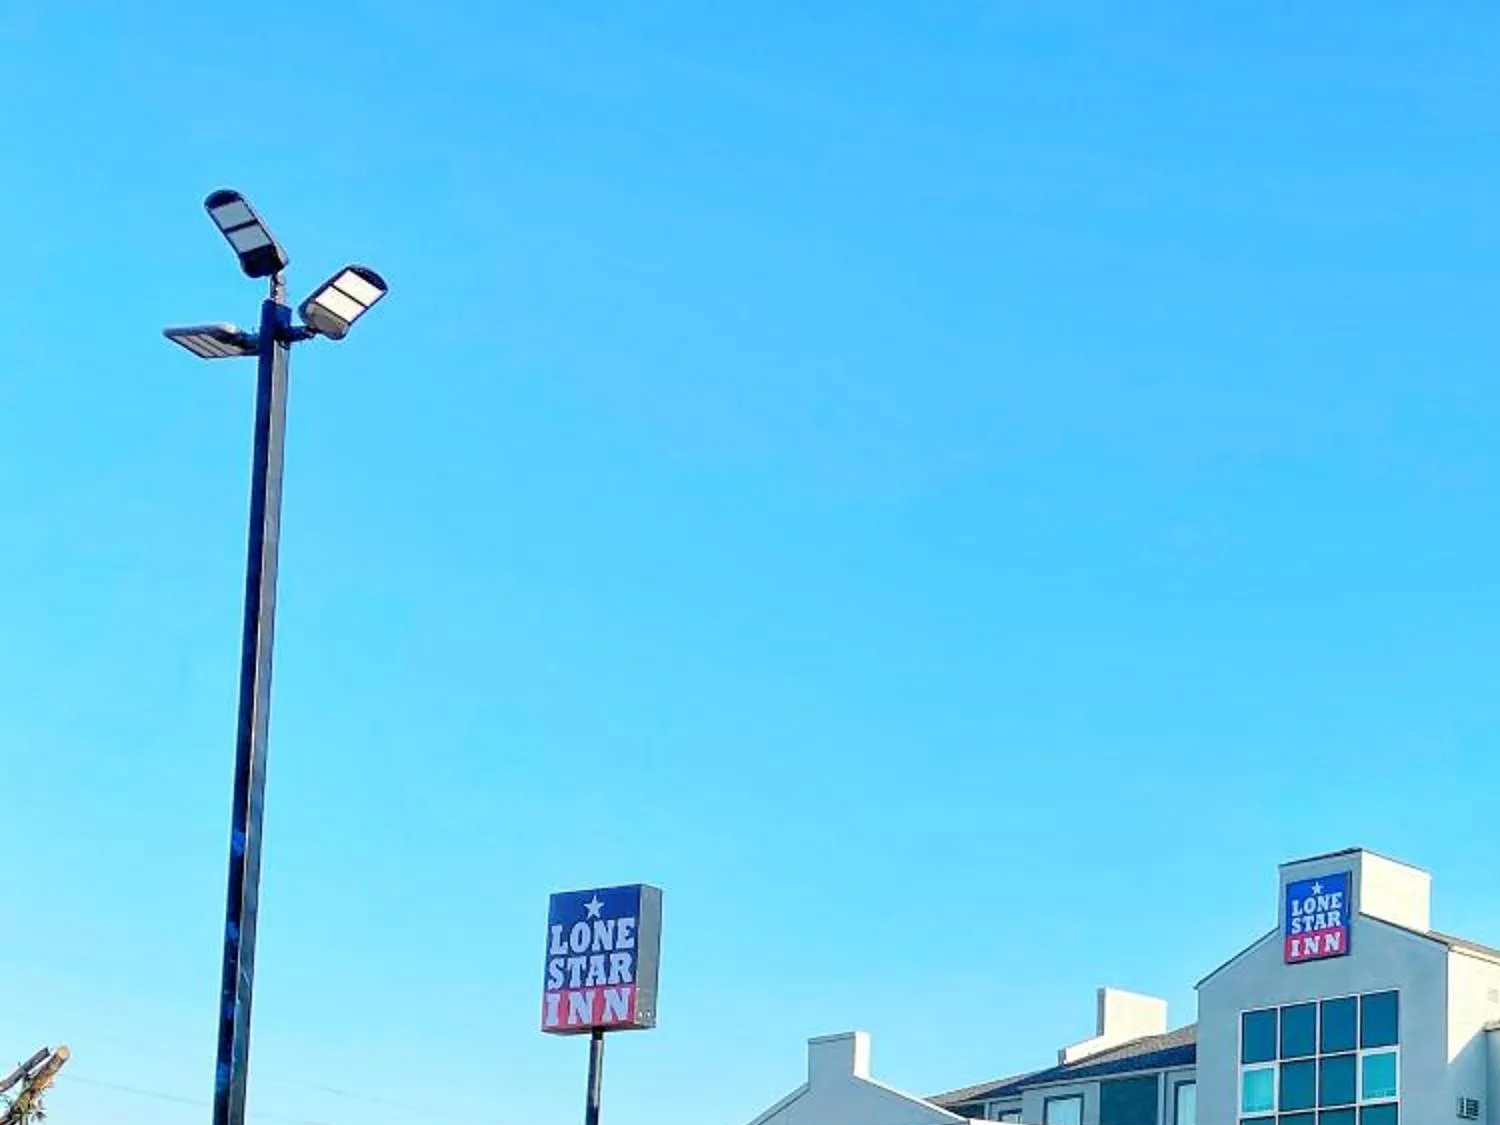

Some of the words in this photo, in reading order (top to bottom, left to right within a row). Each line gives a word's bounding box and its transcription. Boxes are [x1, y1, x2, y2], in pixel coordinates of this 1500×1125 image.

[1291, 892, 1343, 917] LONE
[549, 917, 636, 955] LONE
[1291, 910, 1342, 935] STAR
[1290, 931, 1342, 957] INN
[547, 951, 634, 990] STAR
[545, 987, 632, 1027] INN
